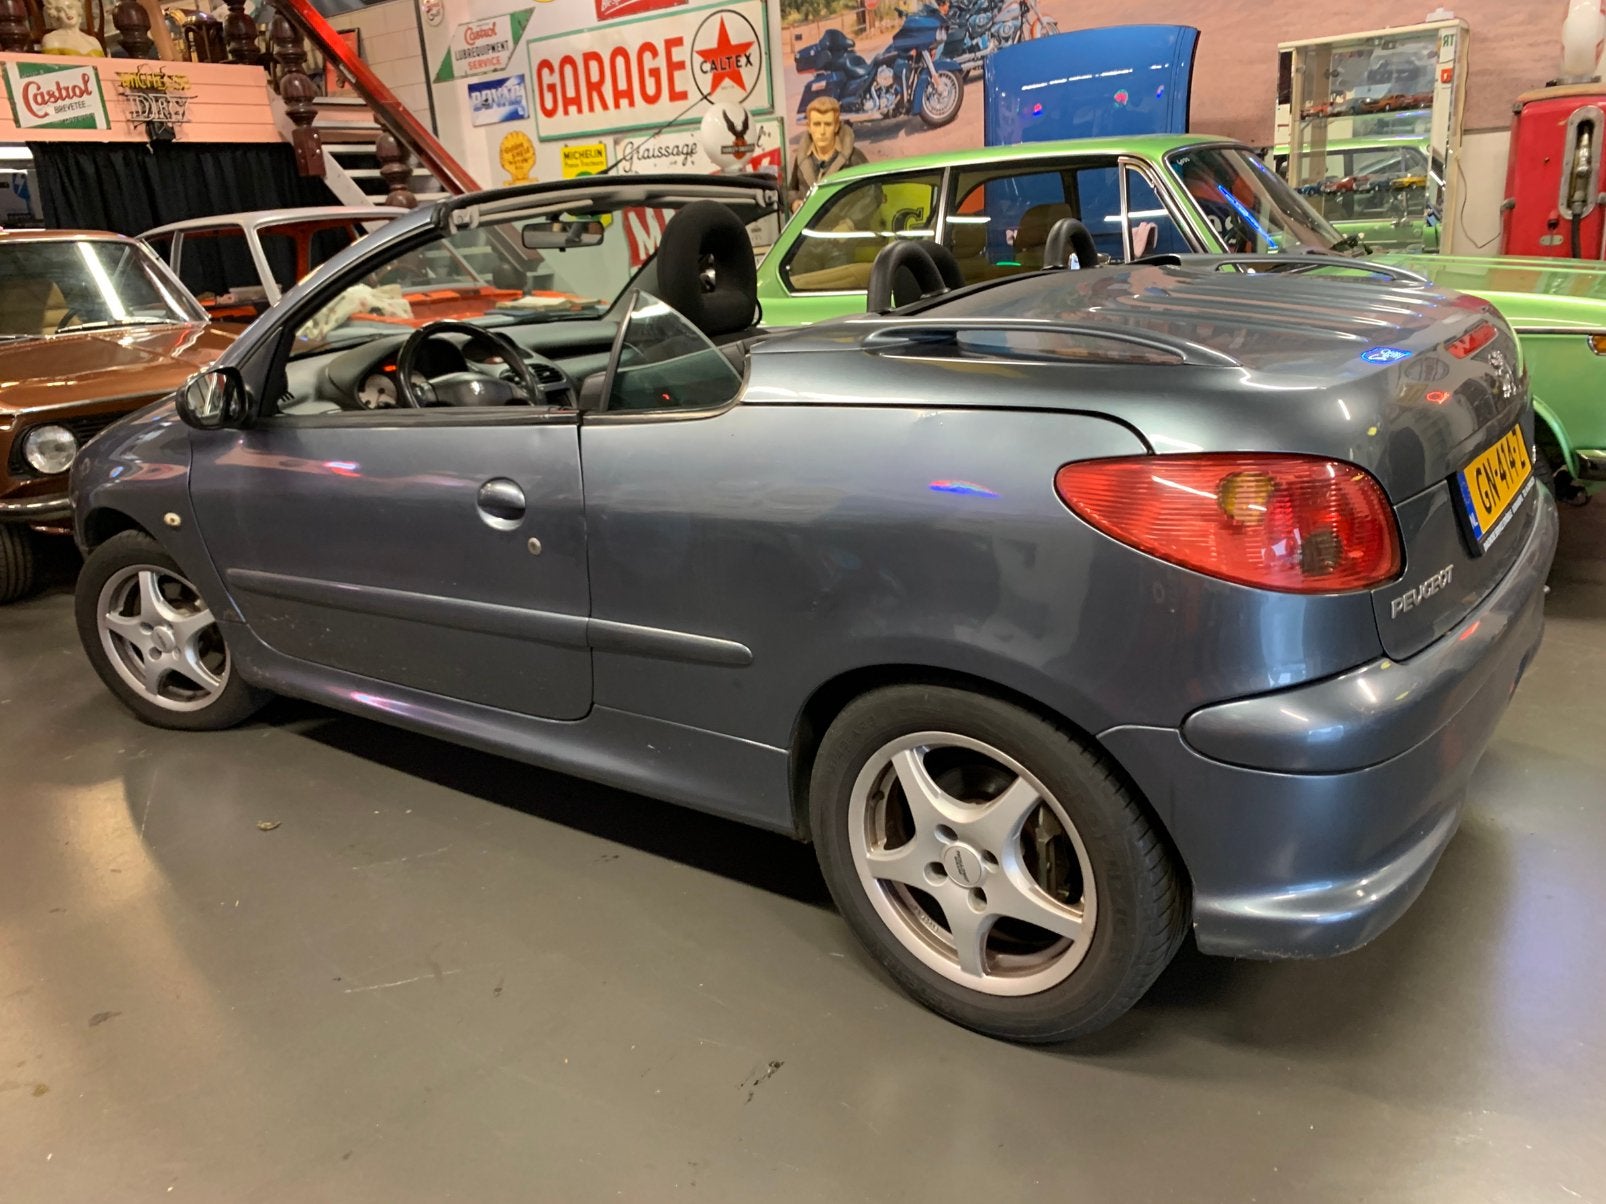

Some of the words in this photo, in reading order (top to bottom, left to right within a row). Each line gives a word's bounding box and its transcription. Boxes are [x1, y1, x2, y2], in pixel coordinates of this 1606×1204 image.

[464, 21, 497, 46] Castrol
[468, 56, 501, 70] SERVICE
[536, 36, 689, 119] GARAGE
[700, 53, 754, 74] CALTEX
[22, 73, 93, 119] Castrol
[563, 149, 603, 161] MICHELIN
[622, 141, 698, 174] Graissage
[1475, 428, 1527, 515] GN-414-Z
[1391, 564, 1454, 619] PEUGEOT
